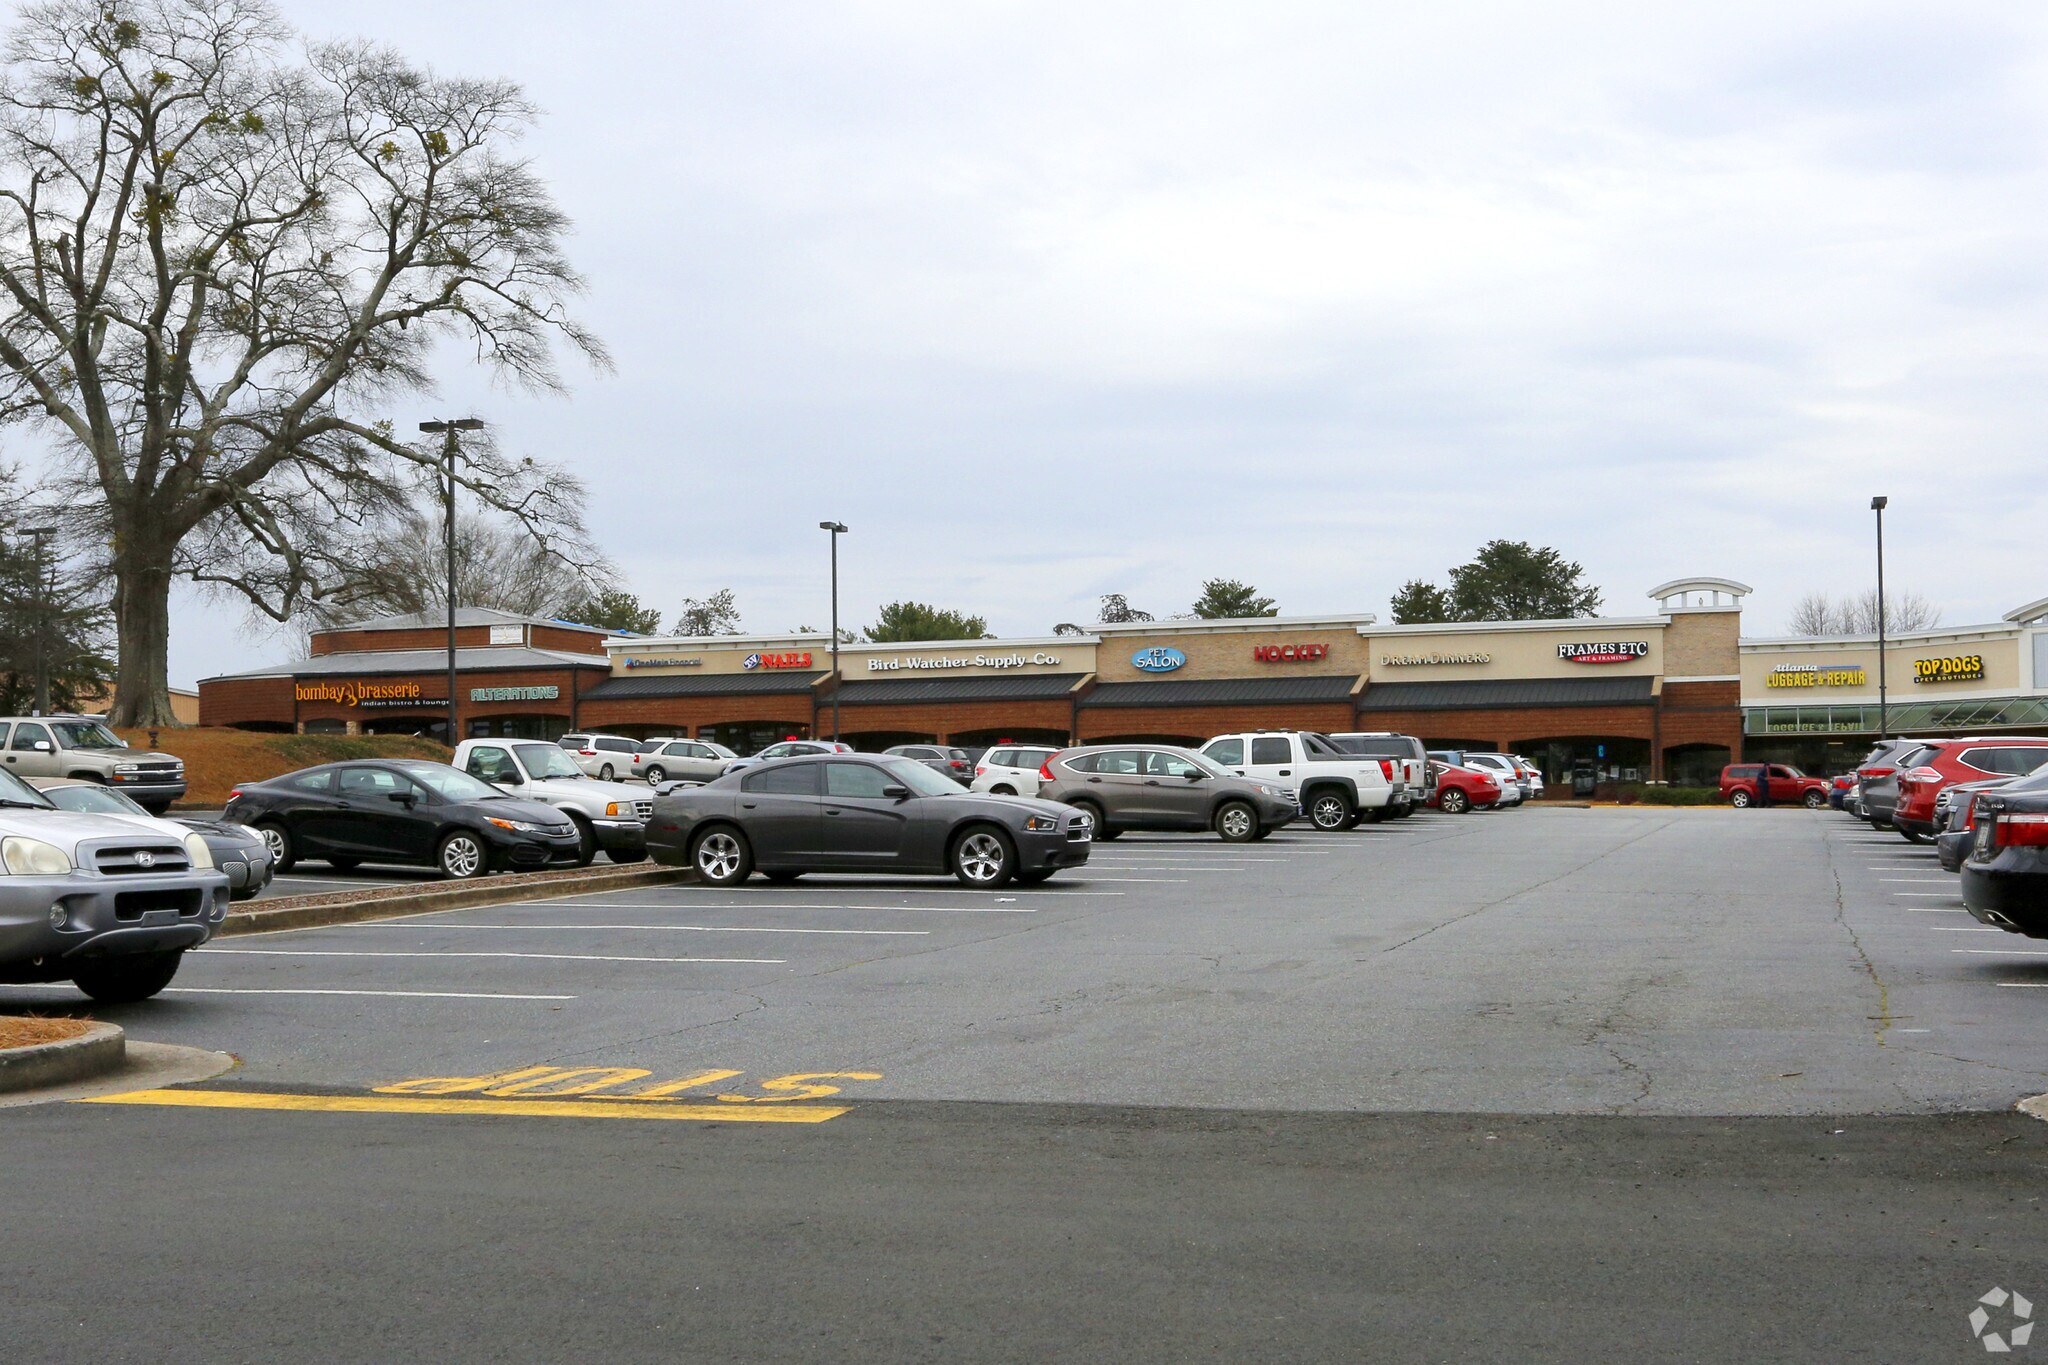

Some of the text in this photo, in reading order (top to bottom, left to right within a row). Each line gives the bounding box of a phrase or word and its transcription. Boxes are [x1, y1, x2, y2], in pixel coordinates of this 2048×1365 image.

[1148, 647, 1167, 656] PET
[1253, 643, 1329, 662] HOCKEY
[1558, 642, 1647, 658] FRAMES ETC
[760, 652, 812, 669] NAILS
[867, 652, 1061, 672] Bird Watcher Supply Co.
[1136, 656, 1181, 668] SALON
[1771, 663, 1819, 672] Atlanta
[1914, 656, 1981, 675] TOP DOGS
[1766, 670, 1865, 688] LUGGAGE & REPAIR
[295, 682, 420, 703] bombay brasserie
[470, 686, 559, 701] ALTERATIONS
[370, 1066, 883, 1102] STOP
